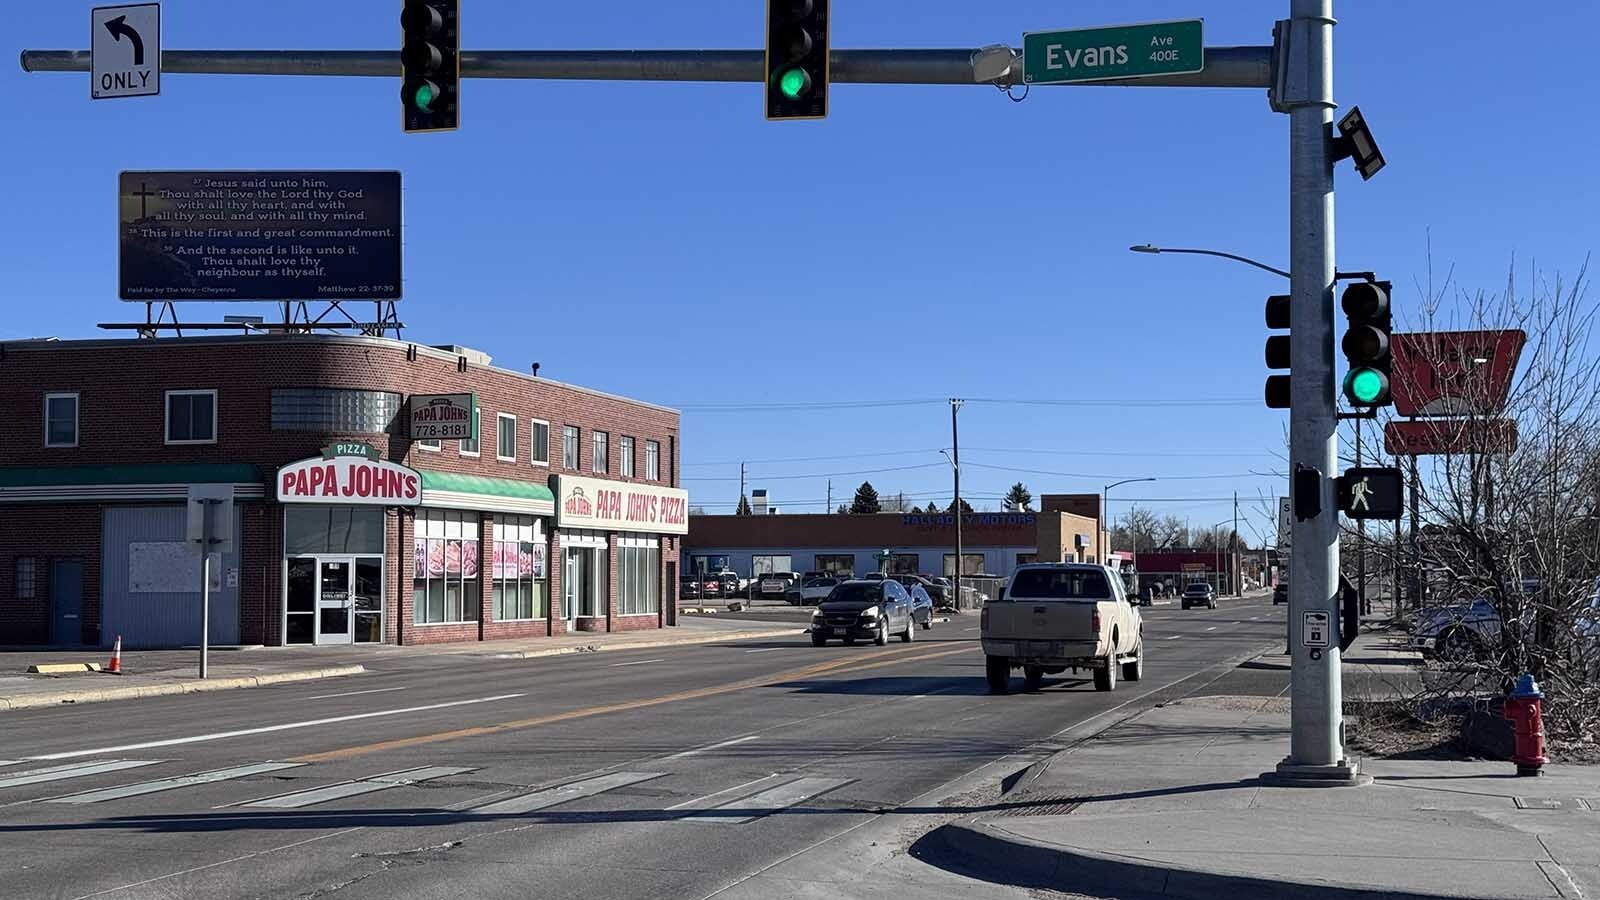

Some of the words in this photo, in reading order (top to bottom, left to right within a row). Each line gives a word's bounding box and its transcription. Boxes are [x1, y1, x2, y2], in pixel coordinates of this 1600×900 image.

[1150, 36, 1173, 46] Ave
[1046, 43, 1129, 70] Evans
[1149, 50, 1179, 62] 400E
[101, 70, 151, 90] ONLY
[205, 179, 238, 188] Jesus
[241, 178, 266, 188] said
[270, 180, 298, 188] unto
[160, 190, 190, 198] Thou
[194, 190, 224, 198] shalt
[228, 190, 253, 198] love
[258, 190, 277, 198] the
[282, 190, 309, 198] Lord
[313, 190, 334, 200] thy
[338, 190, 363, 198] God
[176, 200, 204, 209] with
[208, 200, 223, 209] all
[228, 200, 248, 212] thy
[252, 200, 288, 210] heart,
[291, 200, 314, 208] and
[319, 200, 345, 208] with
[174, 212, 198, 222] thy
[230, 212, 254, 220] and
[258, 212, 285, 220] with
[290, 212, 304, 220] all
[308, 212, 331, 222] thy
[142, 228, 167, 237] This
[171, 228, 180, 237] is
[184, 228, 204, 237] the
[208, 228, 232, 237] first
[236, 228, 260, 237] and
[264, 229, 296, 239] great
[300, 228, 394, 237] commandment.
[176, 246, 203, 254] And
[207, 246, 226, 254] the
[230, 246, 274, 254] second
[277, 246, 287, 254] is
[290, 246, 312, 254] like
[316, 246, 344, 254] unto
[202, 257, 232, 265] Thou
[236, 257, 266, 265] shalt
[271, 257, 296, 265] love
[300, 257, 320, 267] thy
[197, 267, 260, 278] neighbour
[282, 267, 326, 278] thyself.
[414, 407, 436, 421] PAPA
[416, 424, 466, 436] 778-8181
[336, 444, 367, 455] PIZZA
[282, 465, 338, 496] PAPA
[342, 464, 417, 499] JOHN'S
[596, 490, 622, 520] PAPA
[626, 492, 657, 522] JOHN'S
[660, 496, 685, 524] PIZZA
[902, 515, 974, 525] HALLADY
[979, 515, 1034, 525] MOTORS
